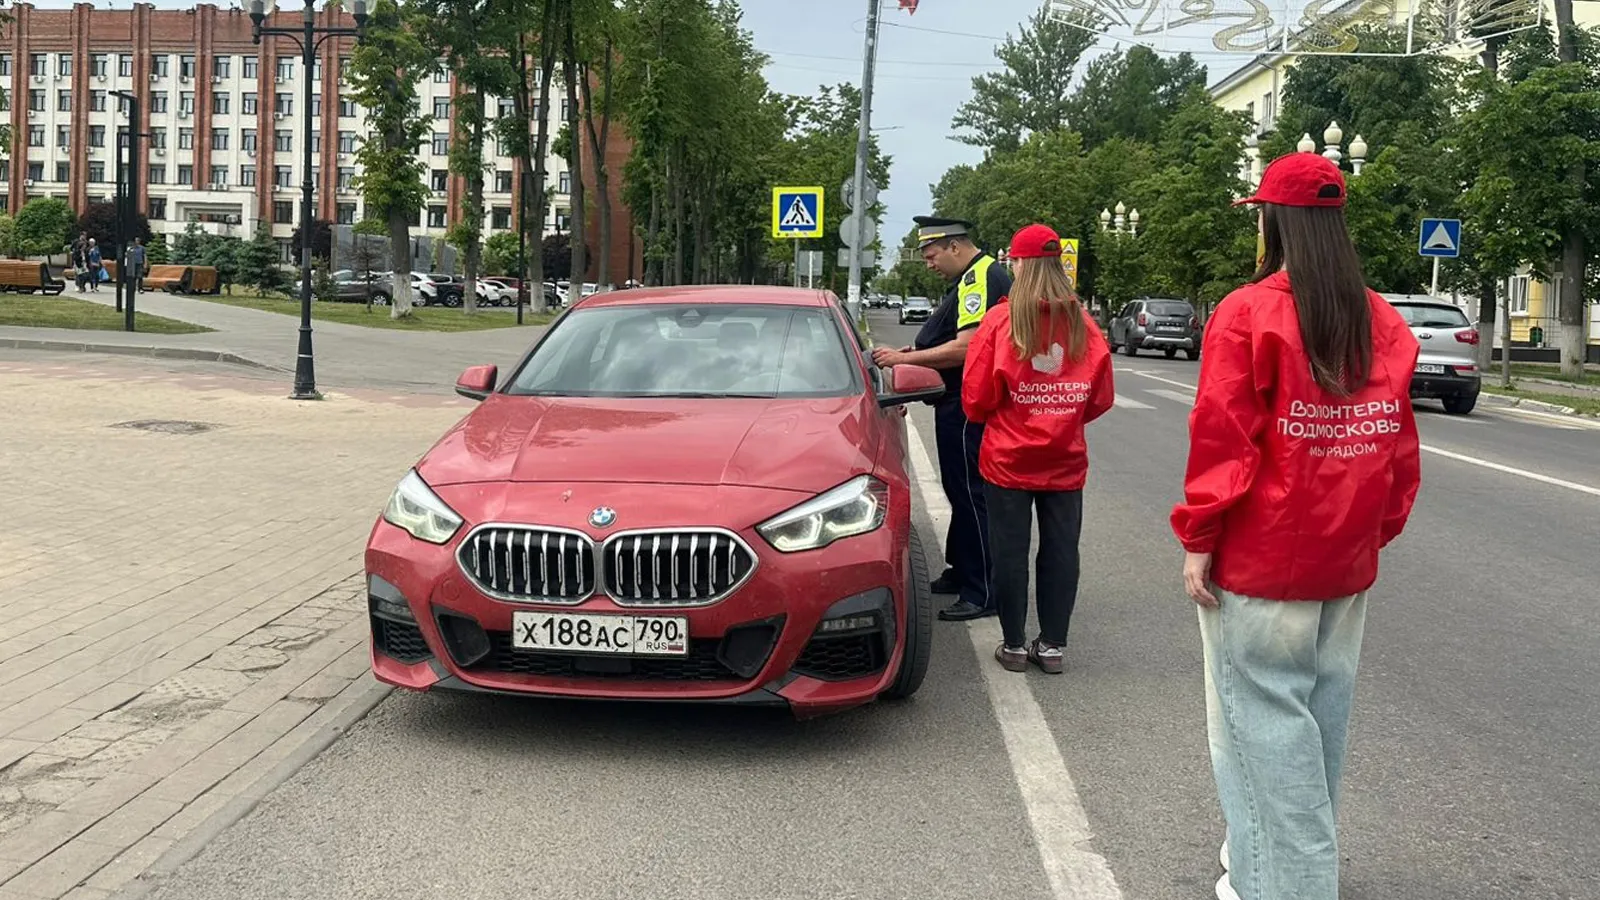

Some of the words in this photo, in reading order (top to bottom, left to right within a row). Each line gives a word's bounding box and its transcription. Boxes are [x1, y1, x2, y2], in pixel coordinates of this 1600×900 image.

[1018, 381, 1092, 392] ВОЛОНТЕРЫ
[1044, 407, 1076, 416] РЯДОМ
[1290, 399, 1400, 419] ВОЛОНТЕРЫ
[1309, 445, 1325, 457] МЫ
[1326, 442, 1377, 458] РЯДОМ
[636, 619, 678, 641] 790
[646, 642, 667, 650] RUS
